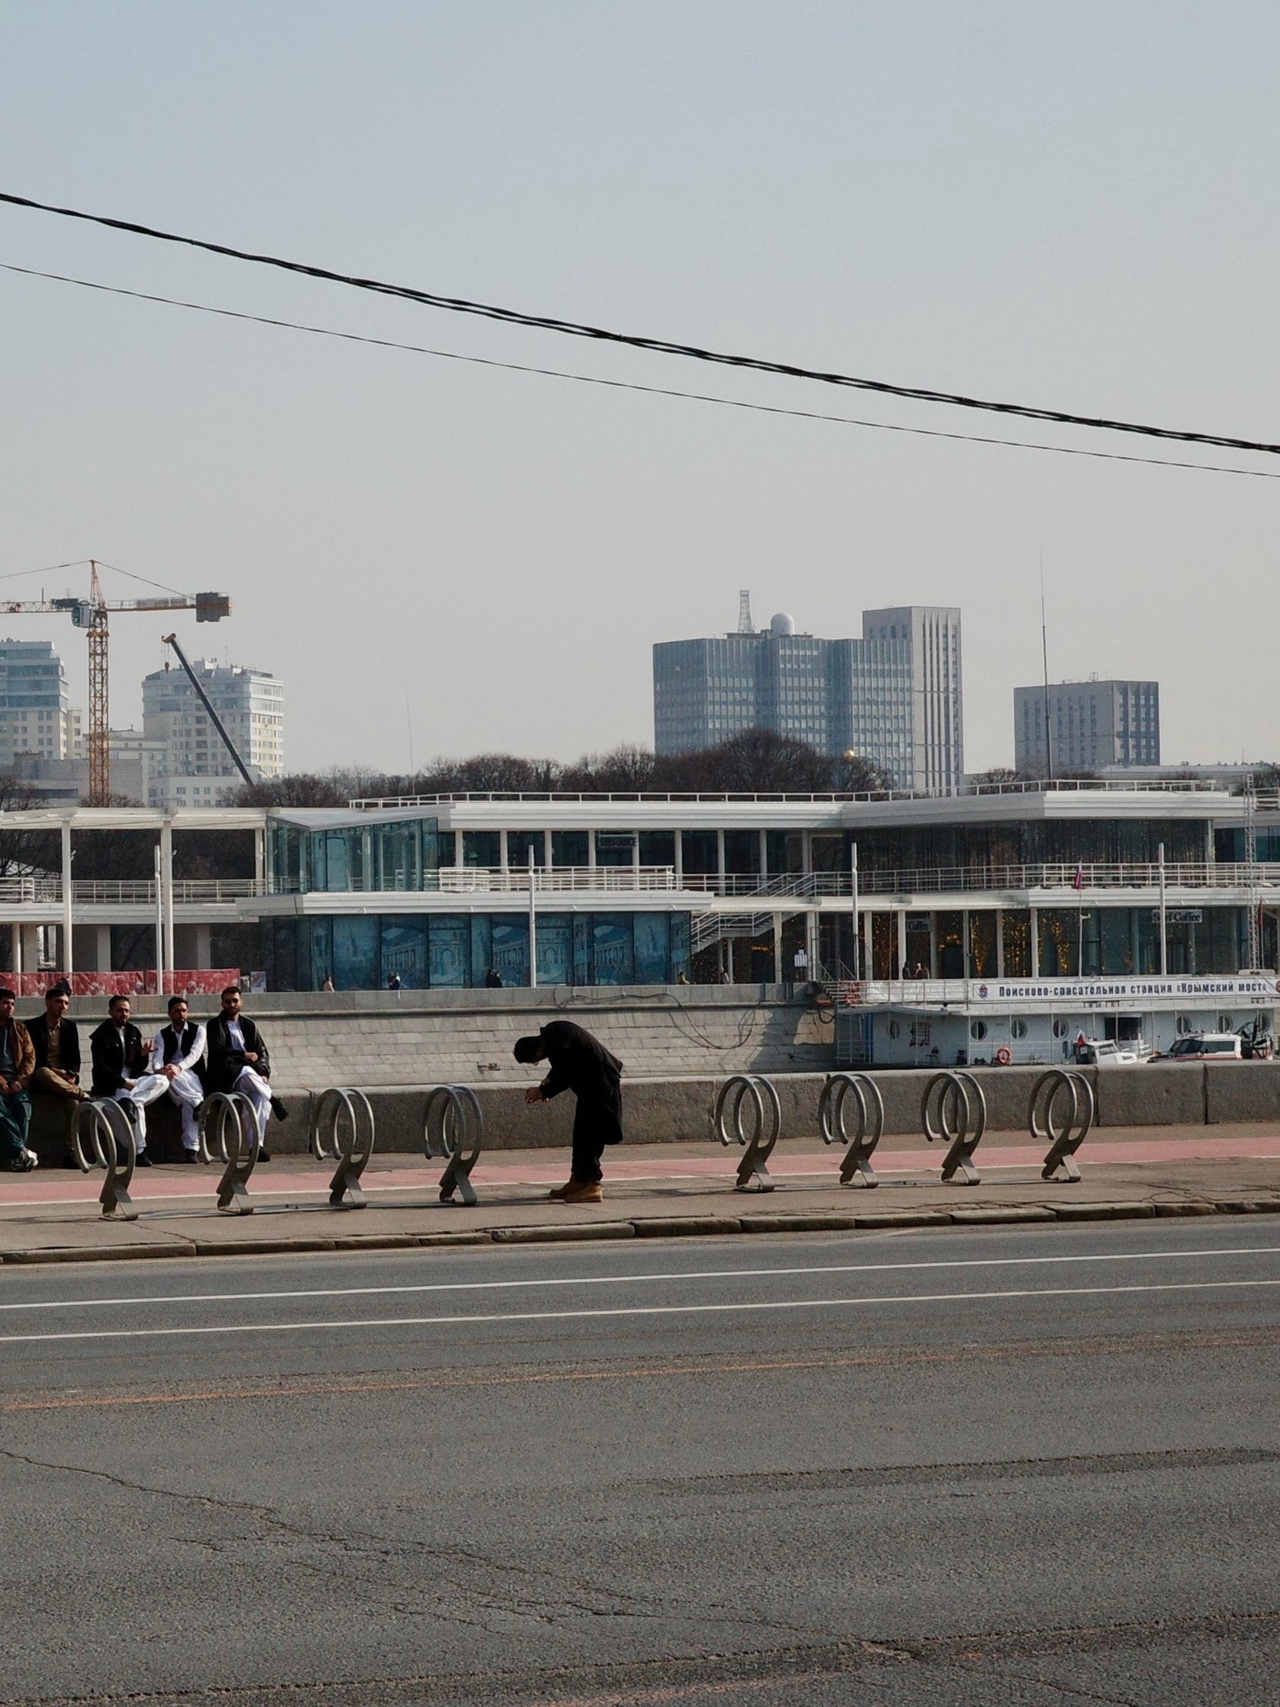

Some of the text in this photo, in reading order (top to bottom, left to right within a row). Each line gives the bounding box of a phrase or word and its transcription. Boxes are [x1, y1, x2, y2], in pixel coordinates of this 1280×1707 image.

[1173, 911, 1201, 922] Coffee
[999, 985, 1126, 997] Поисково-спасательная
[1131, 984, 1172, 995] станция
